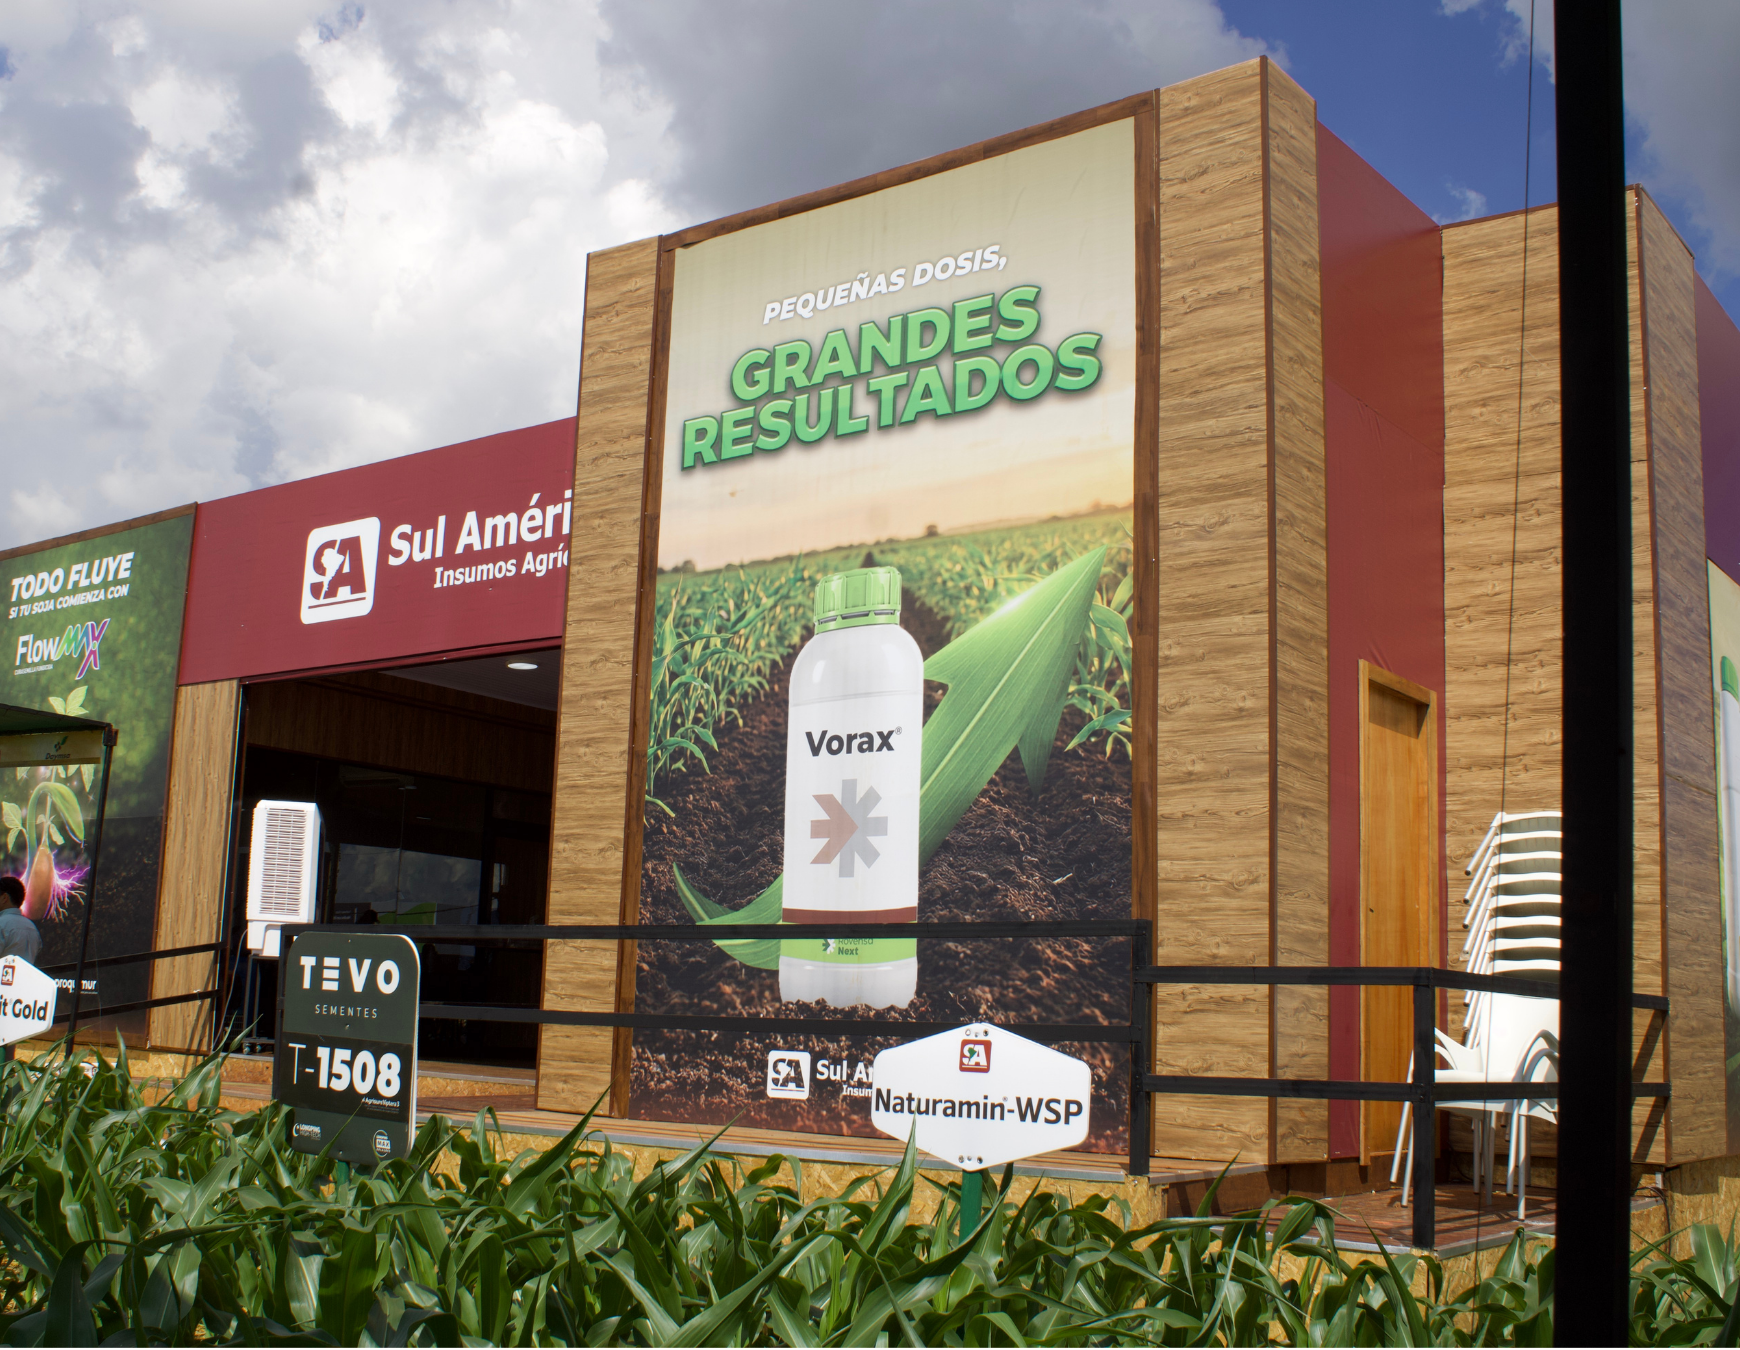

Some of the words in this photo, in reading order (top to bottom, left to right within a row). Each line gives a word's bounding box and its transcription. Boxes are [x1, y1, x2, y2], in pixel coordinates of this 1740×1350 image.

[762, 267, 906, 325] PEQUEÑAS
[911, 244, 1008, 288] DOSIS,
[730, 284, 1042, 402] GRANDES
[680, 332, 1104, 471] RESULTADOS
[387, 514, 446, 566] Sul
[11, 567, 65, 602] TODO
[66, 551, 135, 590] FLUYE
[433, 558, 517, 589] Insumos
[8, 606, 18, 619] SI
[19, 604, 32, 617] TU
[31, 599, 55, 614] SOJA
[56, 589, 105, 609] COMIENZA
[106, 583, 130, 600] CON
[837, 946, 859, 956] Next
[300, 955, 400, 995] TEVO
[12, 998, 49, 1021] Gold
[315, 1004, 378, 1019] SEMENTES
[288, 1042, 401, 1098] T-1508
[816, 1059, 848, 1081] Sul
